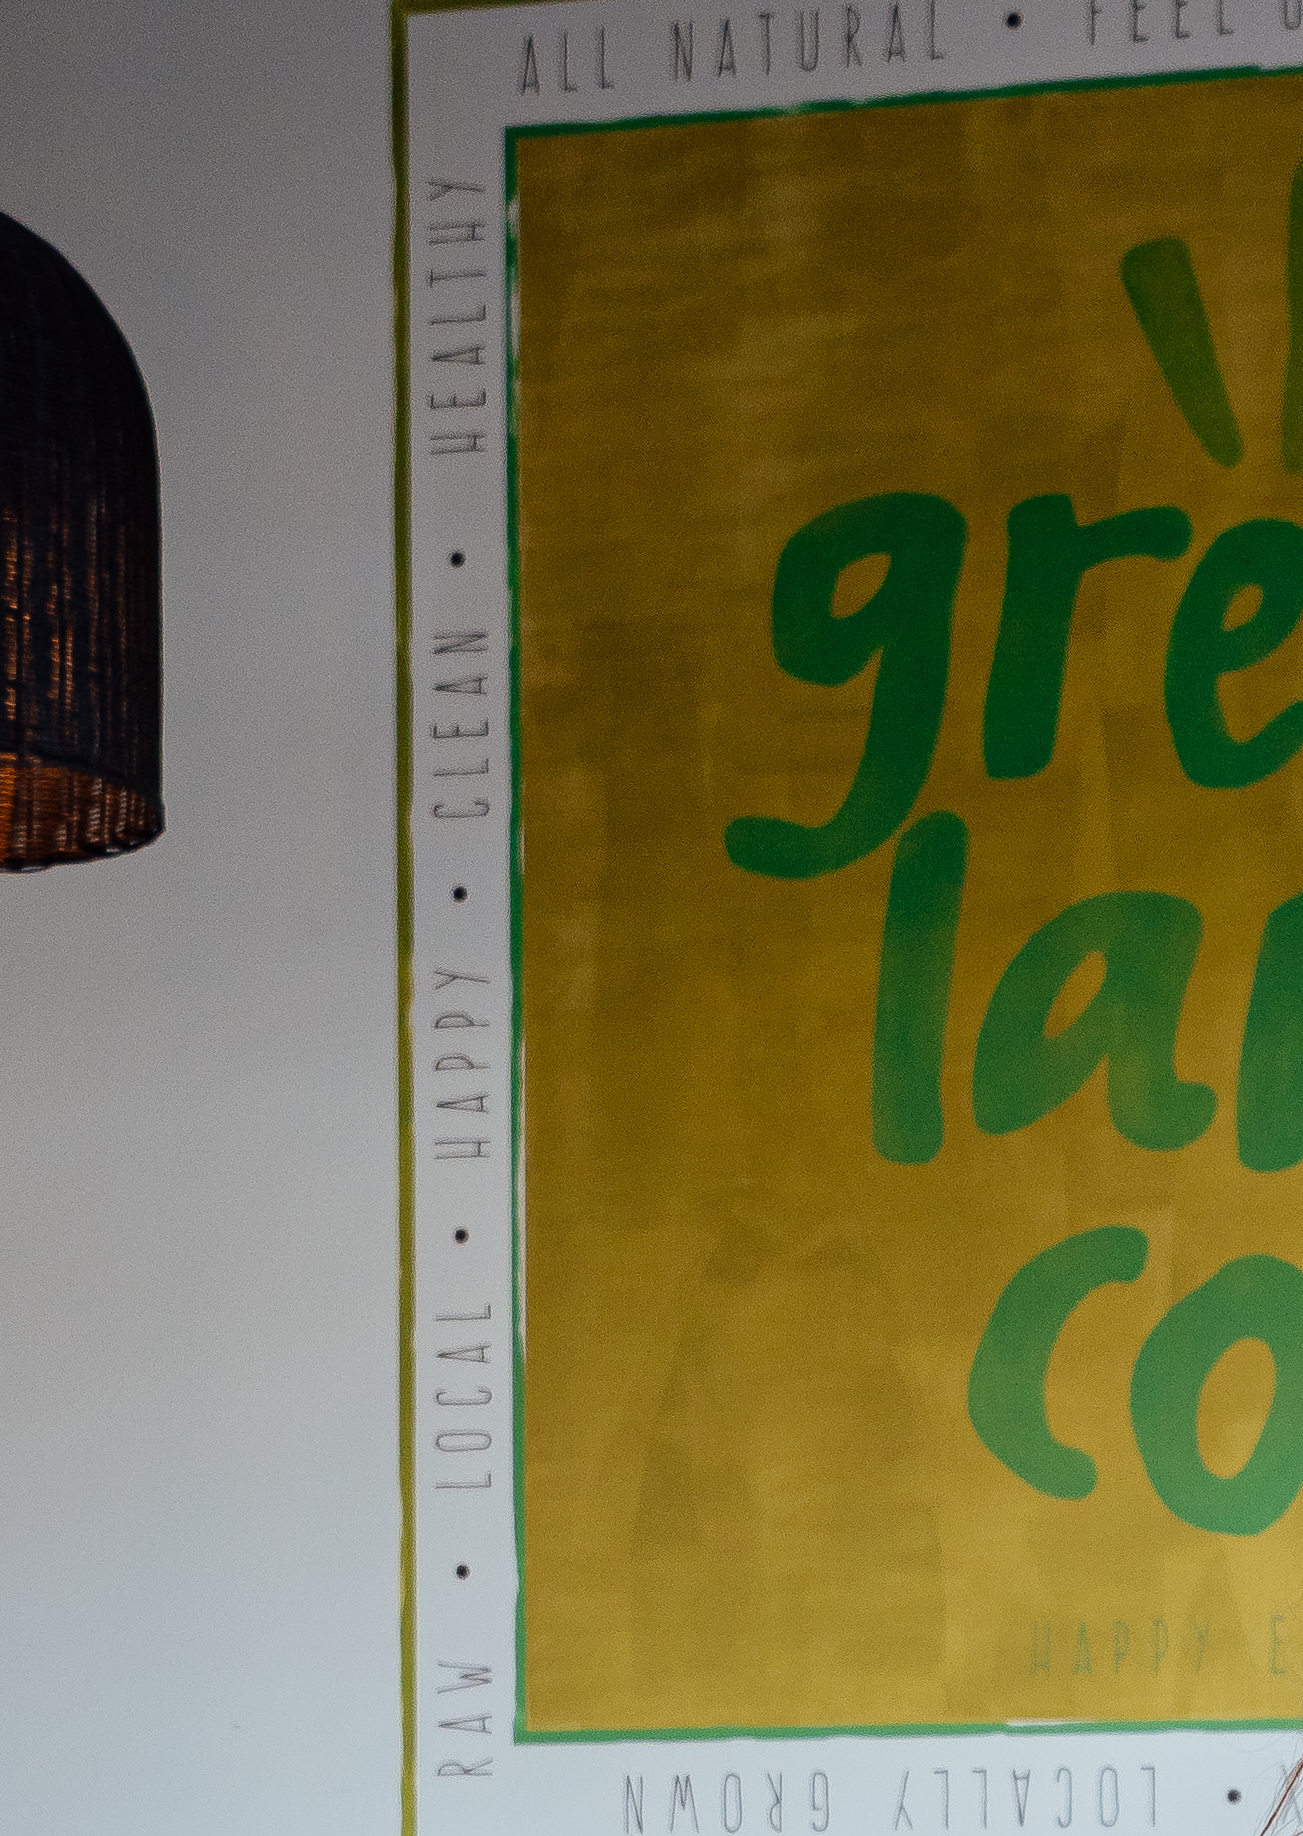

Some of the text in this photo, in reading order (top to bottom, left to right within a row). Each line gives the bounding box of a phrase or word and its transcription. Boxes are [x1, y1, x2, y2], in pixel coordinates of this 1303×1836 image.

[517, 27, 614, 94] ALL
[671, 0, 945, 81] NATURAL
[428, 179, 493, 1777] RAW LOCAL HAPPY CLEAN HEALTHY
[1029, 1616, 1211, 1678] HAPPY
[622, 1764, 1157, 1835] LOCALLY GROWN
